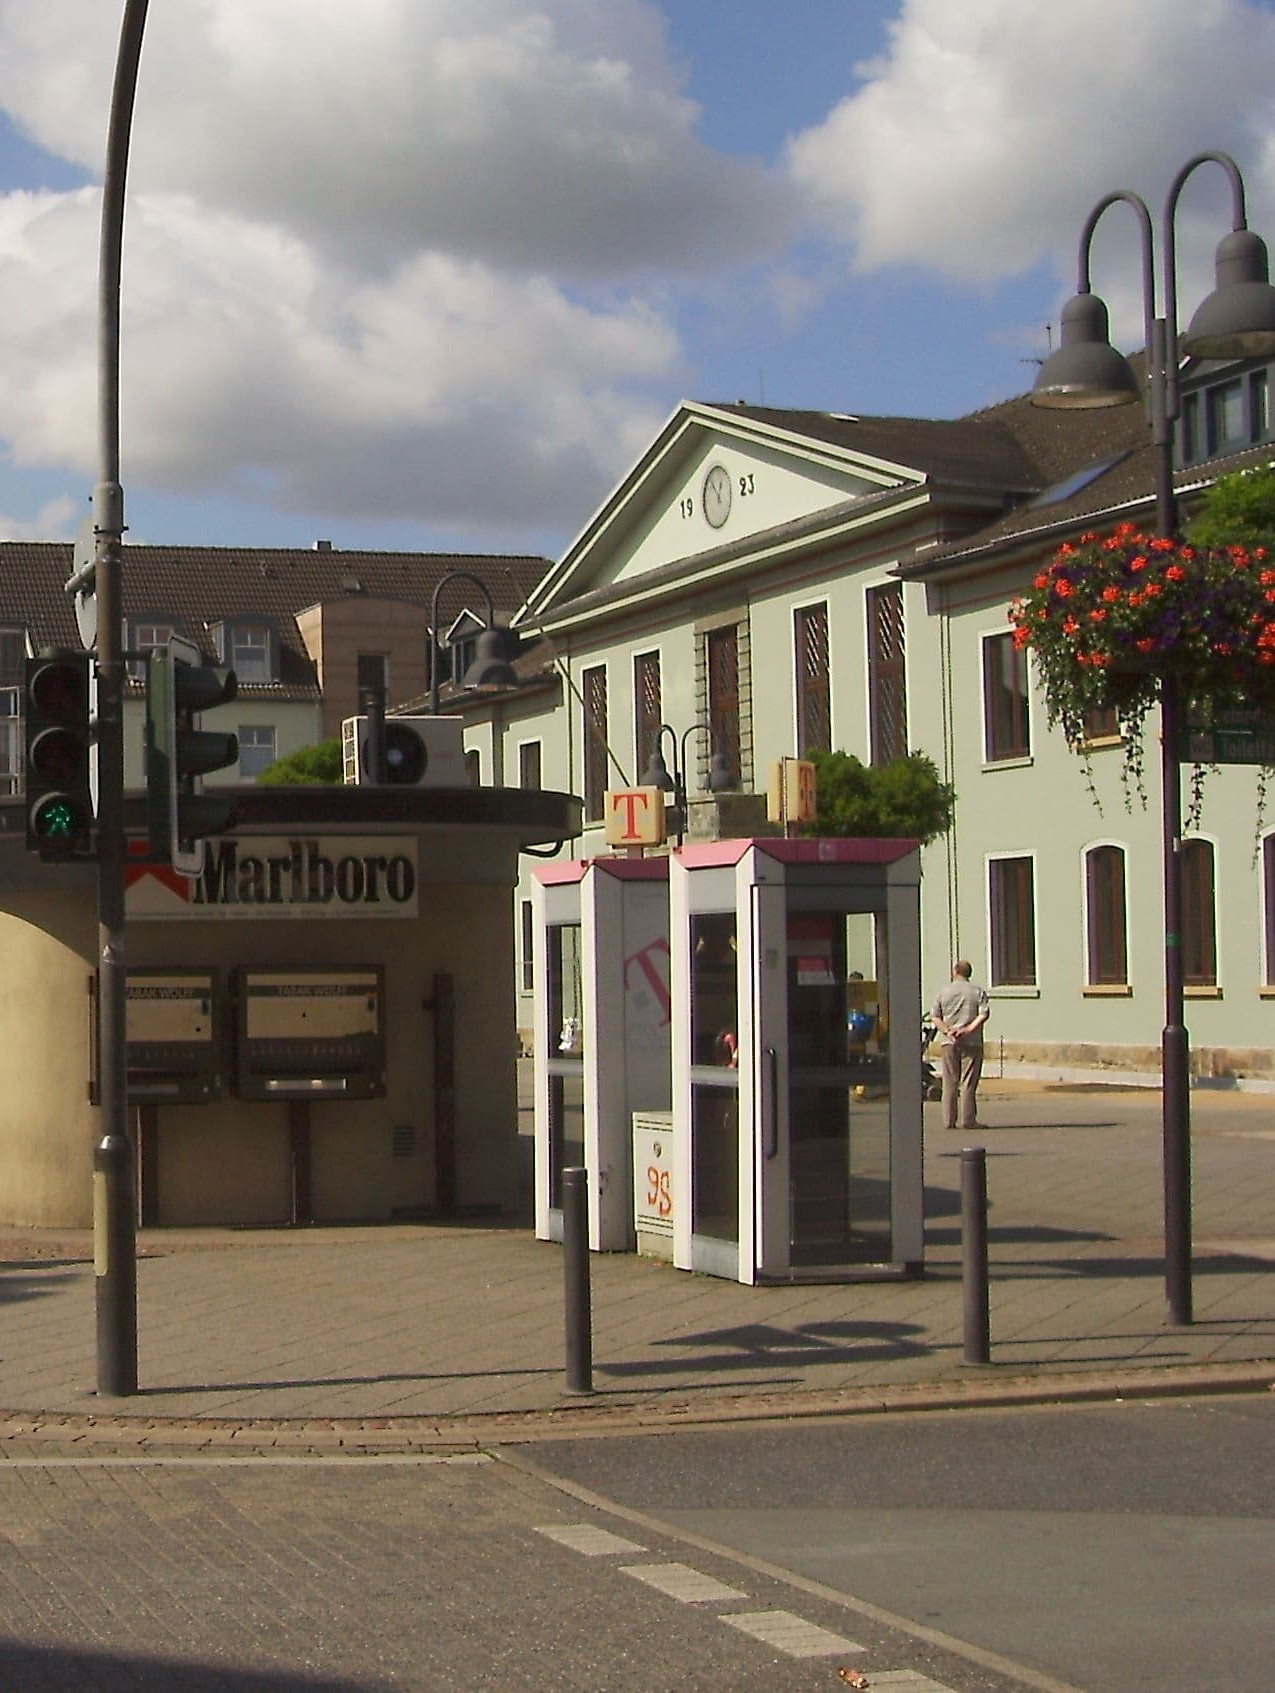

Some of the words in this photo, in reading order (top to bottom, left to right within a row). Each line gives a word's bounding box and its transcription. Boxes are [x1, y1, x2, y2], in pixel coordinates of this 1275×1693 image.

[739, 473, 755, 497] 23
[680, 498, 693, 519] 19
[613, 793, 648, 839] T
[193, 839, 415, 904] Marlboro
